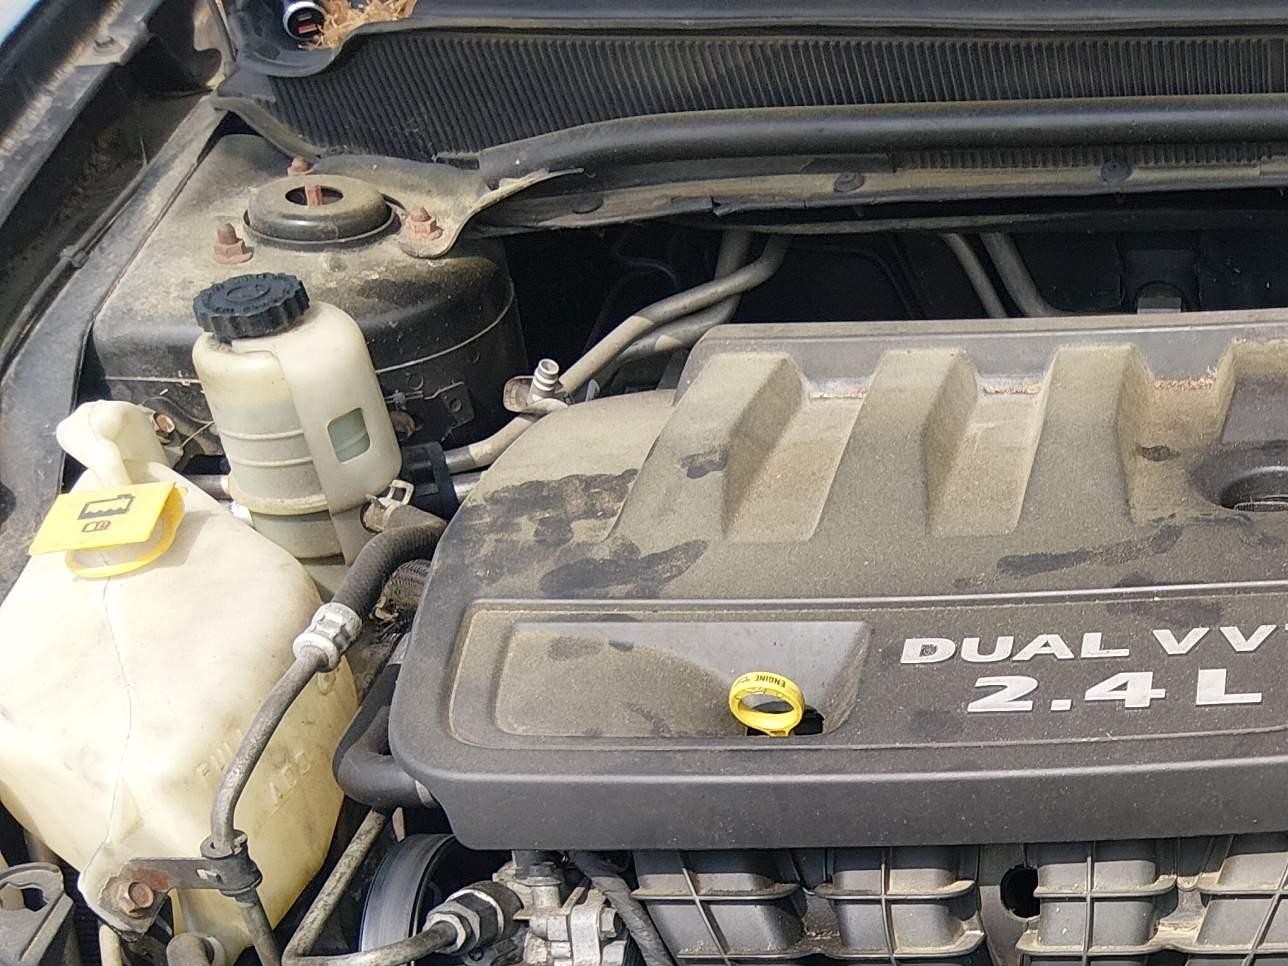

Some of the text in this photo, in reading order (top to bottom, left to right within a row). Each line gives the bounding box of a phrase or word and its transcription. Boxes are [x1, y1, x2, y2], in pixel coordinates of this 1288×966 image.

[899, 631, 1131, 664] DUAL
[754, 674, 787, 689] ENGINE
[966, 671, 1168, 713] 2.4
